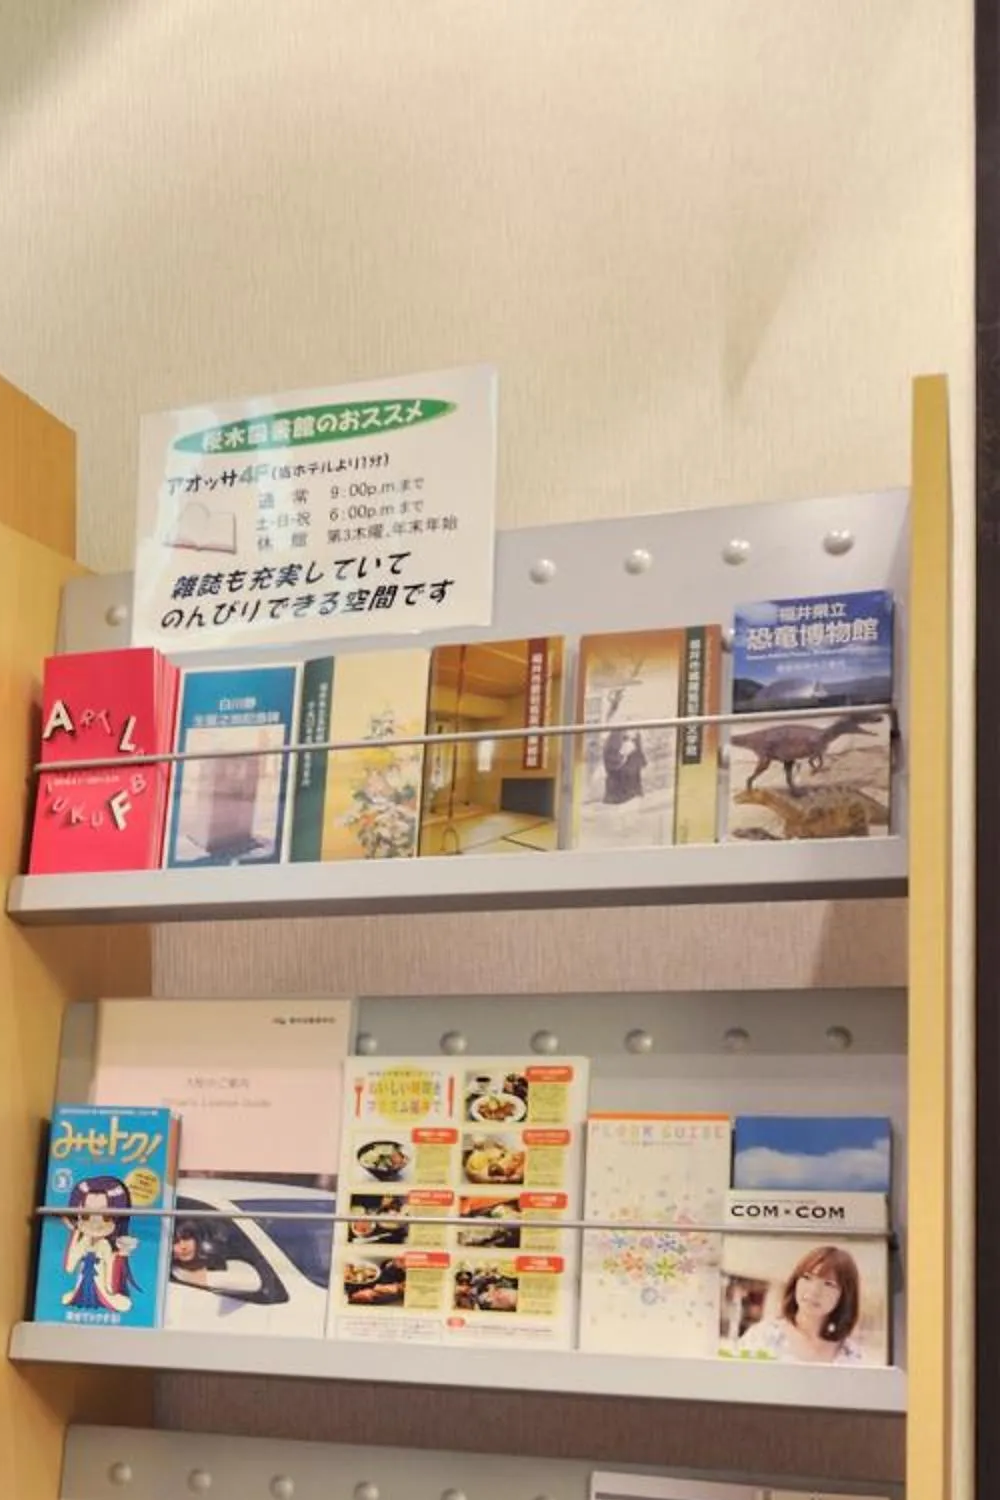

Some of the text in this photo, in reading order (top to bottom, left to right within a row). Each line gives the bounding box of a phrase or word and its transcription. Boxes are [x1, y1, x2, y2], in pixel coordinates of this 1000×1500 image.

[171, 552, 412, 601] 雑誌も充実していて
[161, 578, 456, 630] のんびりできる空間です
[746, 616, 880, 652] 恐竜博物館
[731, 1203, 846, 1220] COM COM
